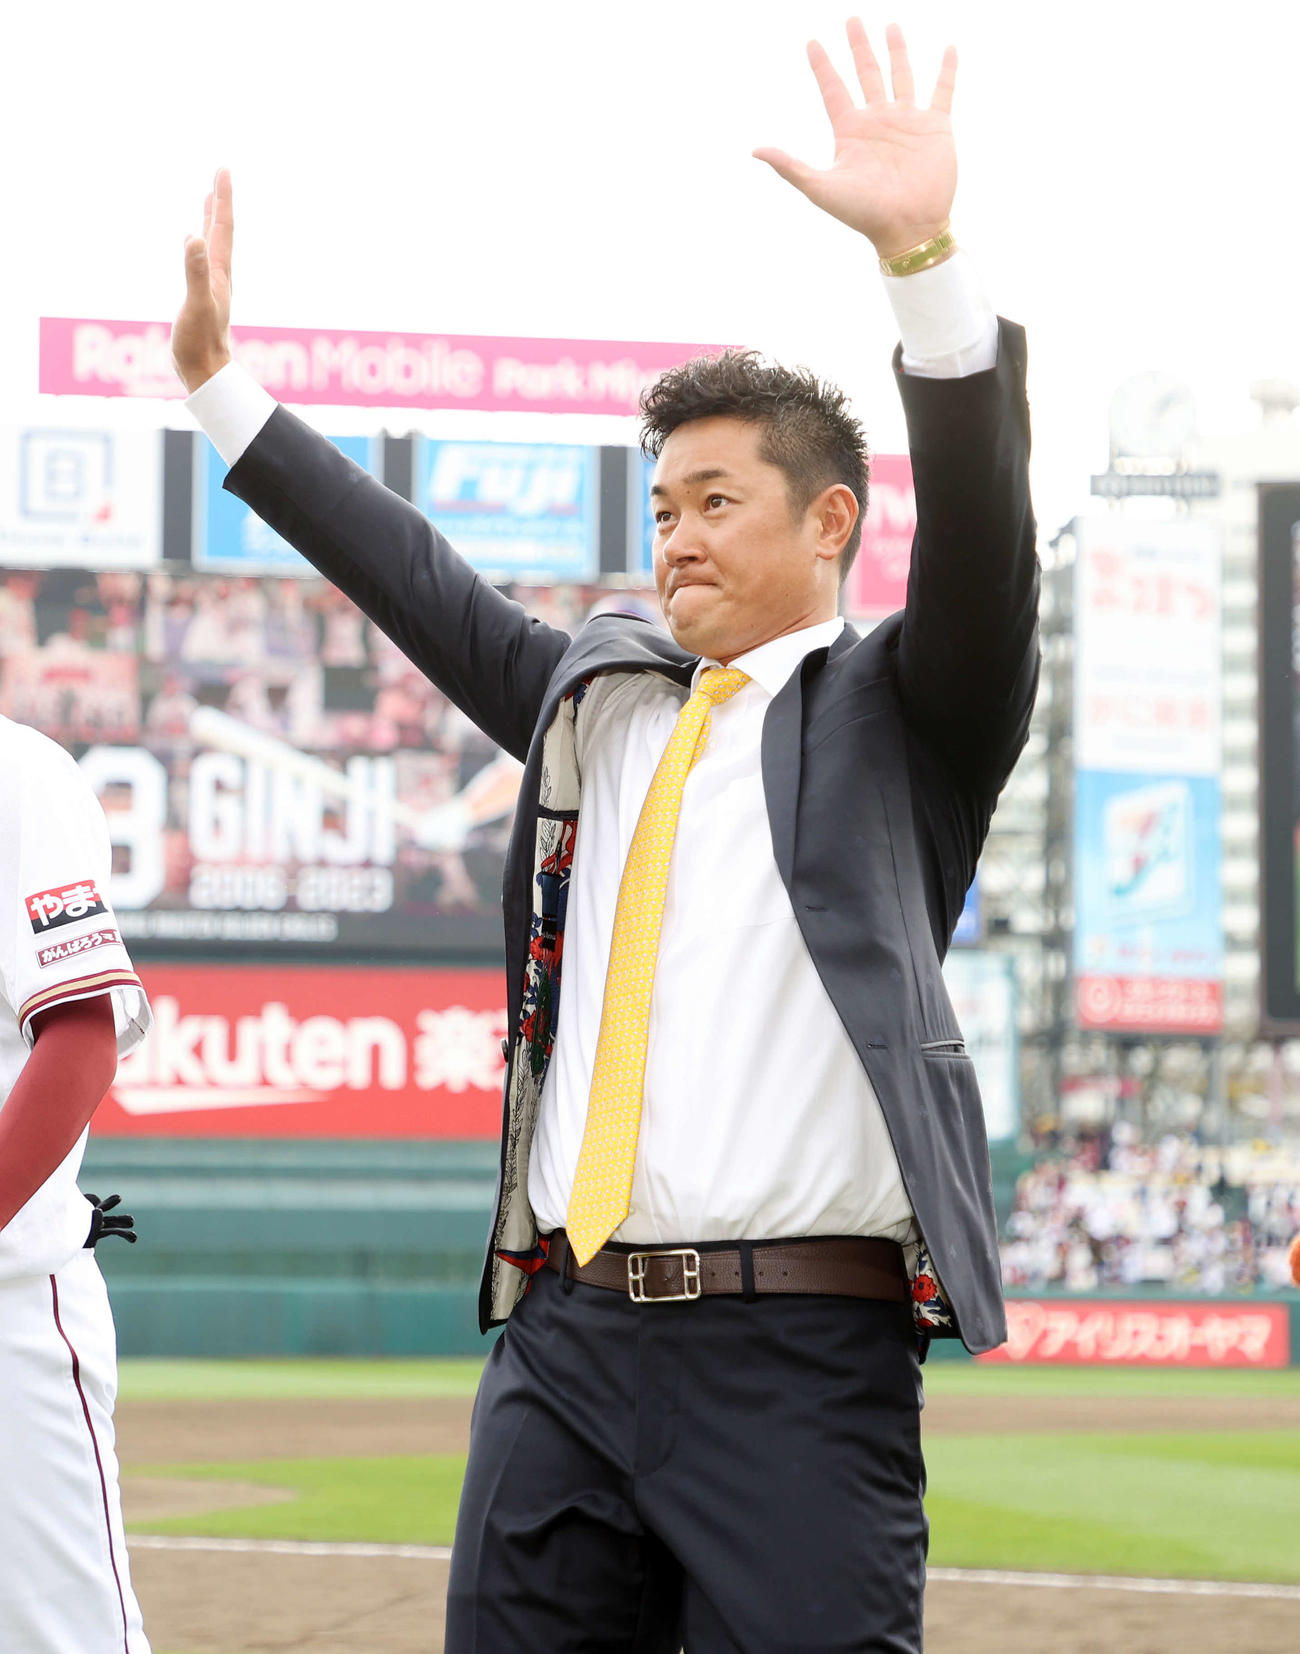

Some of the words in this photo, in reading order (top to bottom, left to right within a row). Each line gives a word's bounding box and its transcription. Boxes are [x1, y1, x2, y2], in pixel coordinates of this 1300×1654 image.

[309, 335, 485, 400] Mobile
[30, 885, 103, 926] やま
[1039, 1309, 1272, 1362] アイリスオーヤマ
